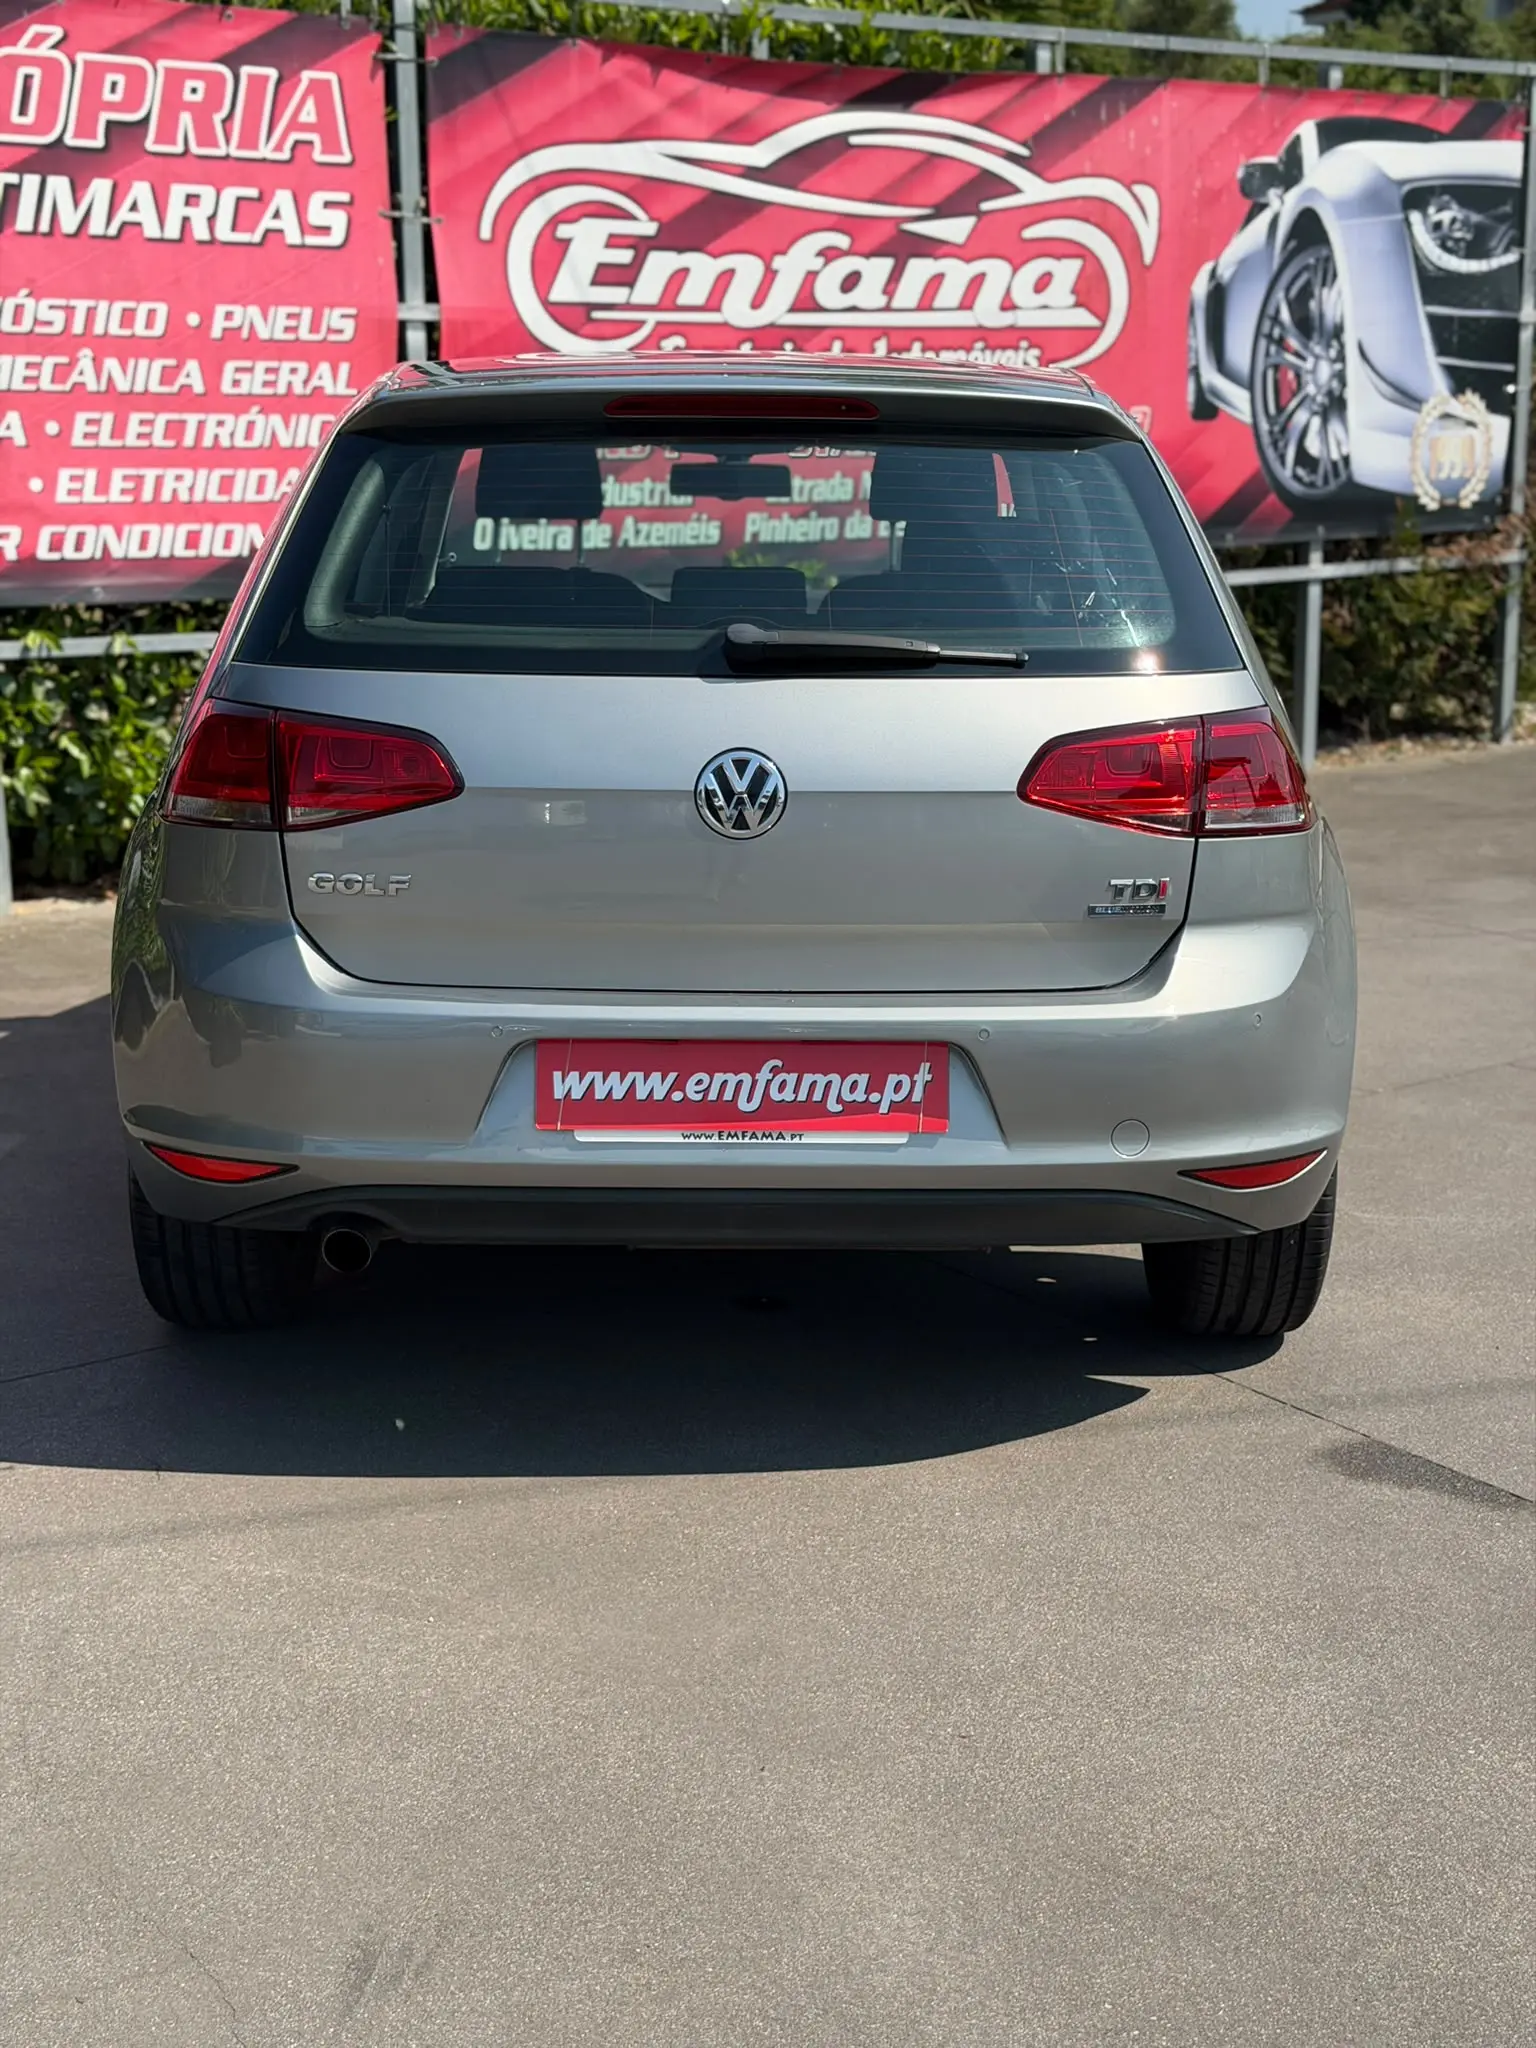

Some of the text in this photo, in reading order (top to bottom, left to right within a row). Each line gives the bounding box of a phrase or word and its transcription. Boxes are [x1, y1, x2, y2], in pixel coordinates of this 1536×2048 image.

[0, 24, 353, 164] ÓPRIA
[548, 217, 1085, 328] Emfama
[210, 304, 358, 342] PNEUS
[220, 361, 358, 396] GERAL
[766, 471, 854, 503] trada
[473, 517, 575, 551] Oiveira
[581, 519, 611, 549] de
[617, 513, 721, 548] Azeméis
[744, 510, 840, 543] Pinheiro
[844, 509, 873, 539] da
[307, 872, 412, 896] GOLF
[1109, 877, 1170, 900] TDI
[553, 1059, 932, 1114] www.emfama.pt
